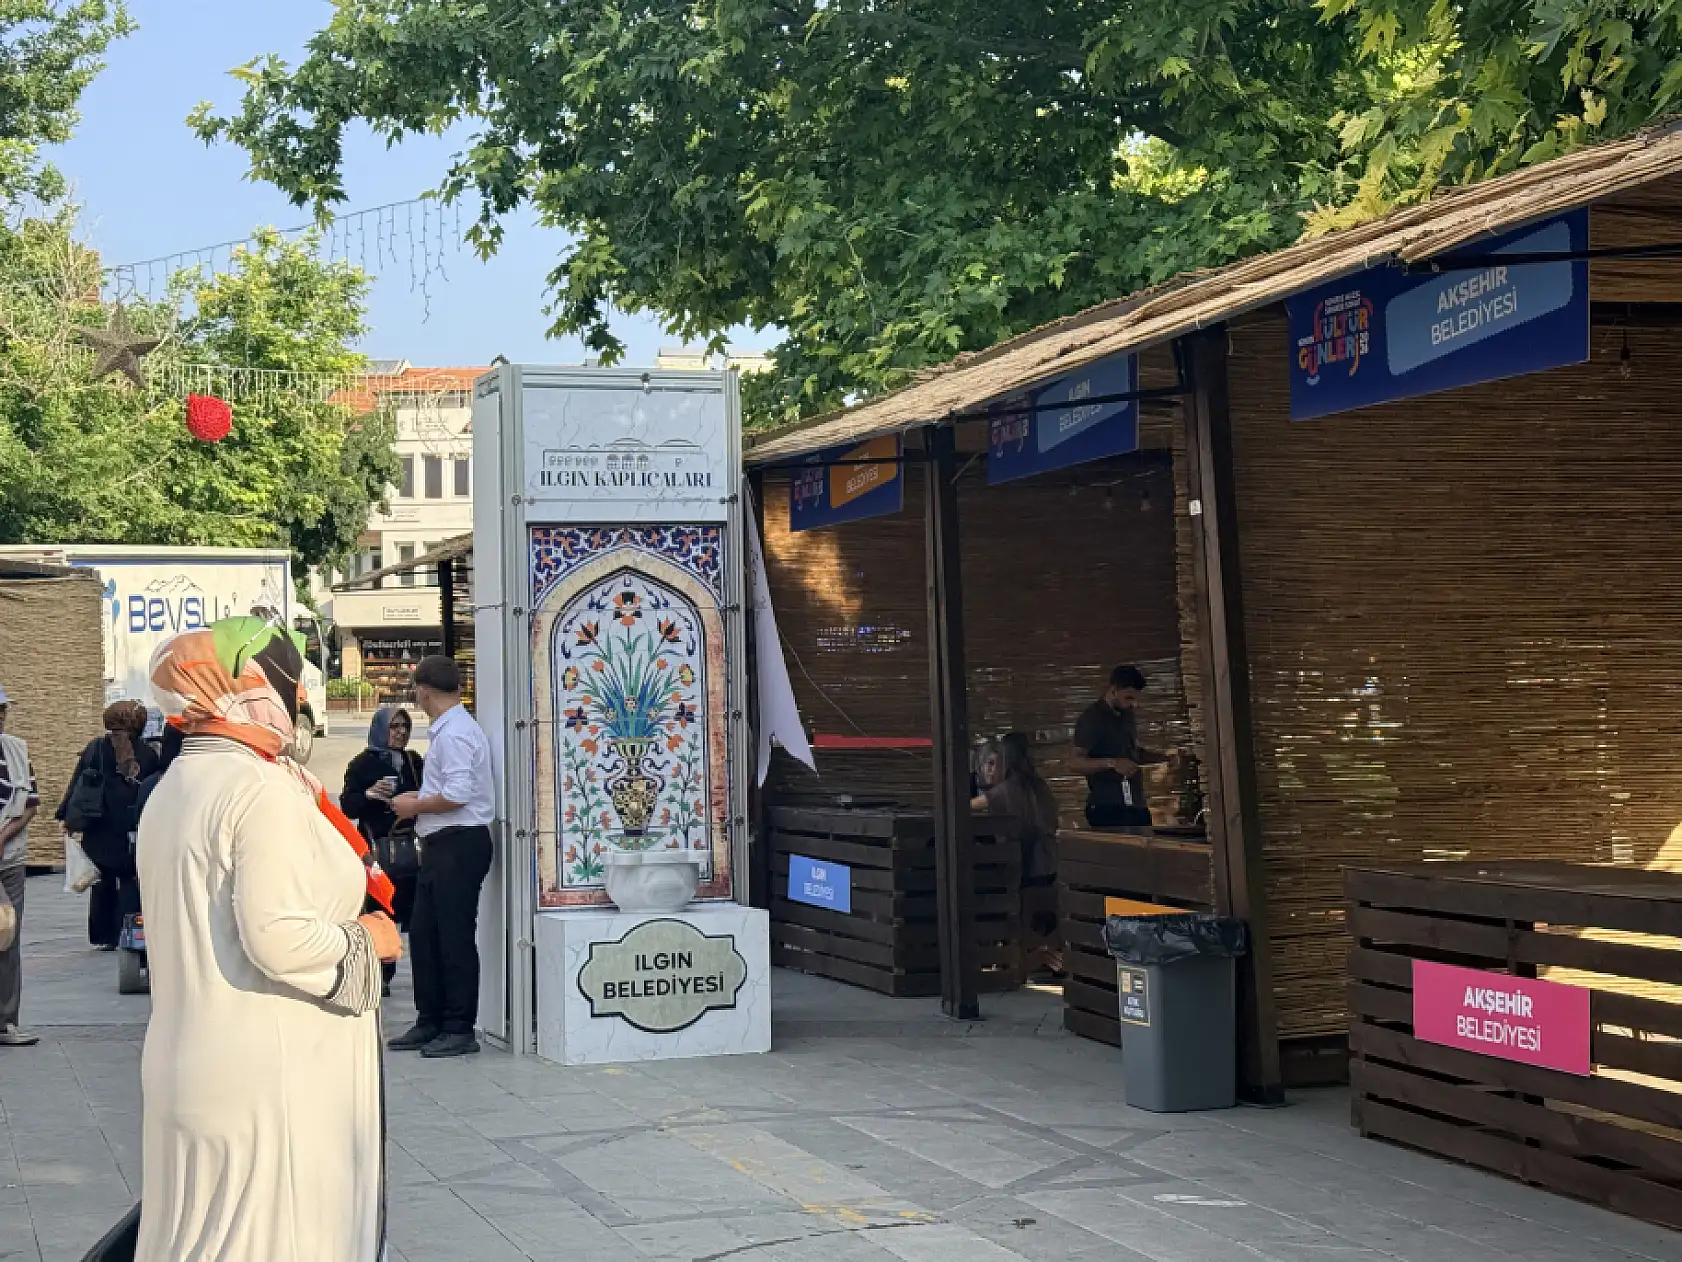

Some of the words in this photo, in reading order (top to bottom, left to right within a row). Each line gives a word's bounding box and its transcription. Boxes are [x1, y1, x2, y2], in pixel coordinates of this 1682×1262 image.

[1431, 285, 1517, 346] BELEDİYESİ
[540, 470, 589, 486] ILGIN
[595, 470, 712, 487] KAPLICALARI
[635, 951, 693, 971] ILGIN
[603, 971, 724, 999] BELEDİYESİ
[1463, 986, 1533, 1018] AKŞEHİR
[1456, 1015, 1541, 1051] BELEDİYESİ
